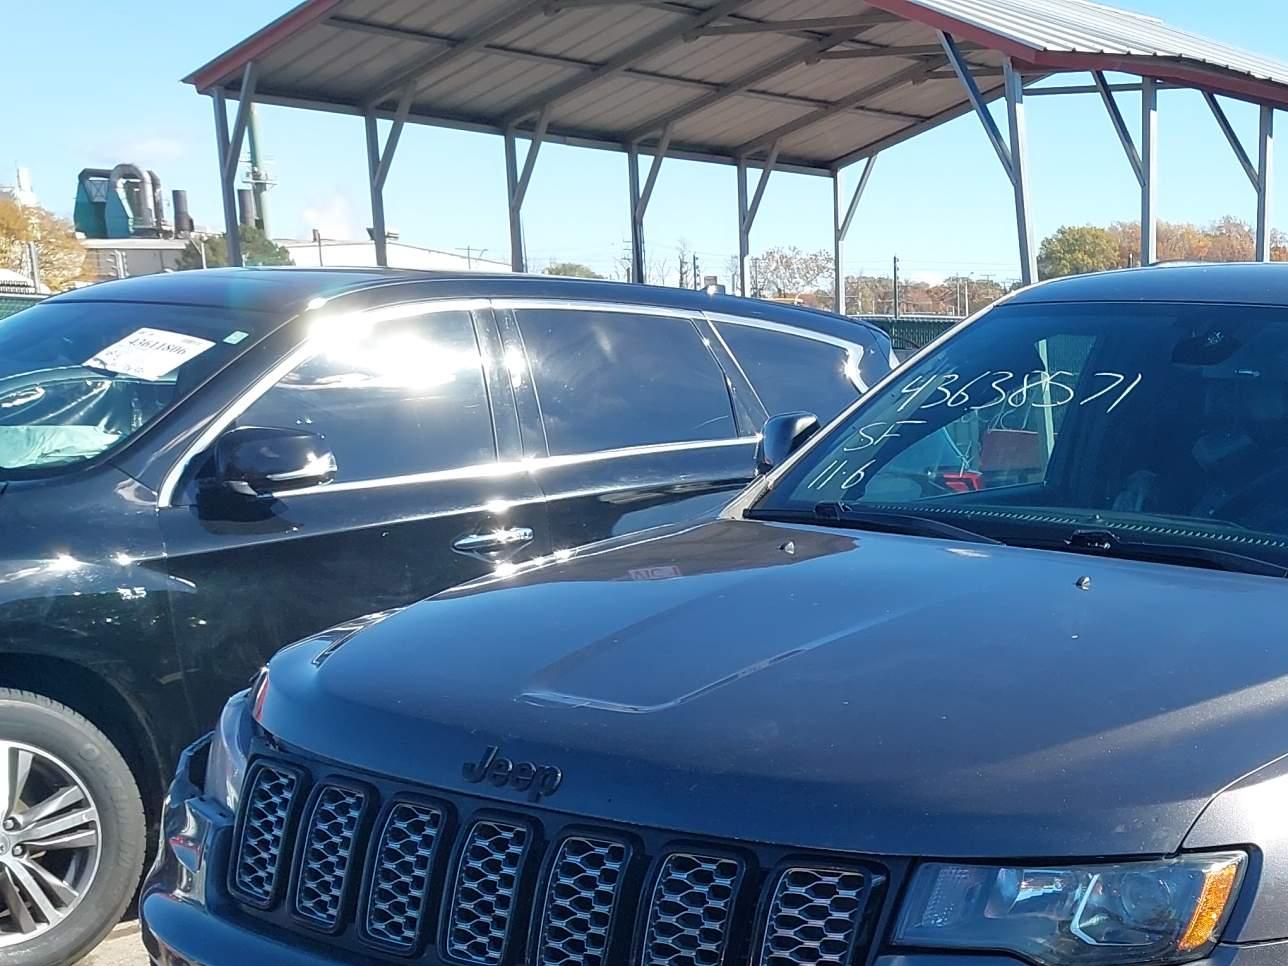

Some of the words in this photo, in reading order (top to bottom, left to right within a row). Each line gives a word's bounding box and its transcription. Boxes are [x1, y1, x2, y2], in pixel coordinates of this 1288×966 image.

[896, 370, 1143, 413] 43638571
[842, 420, 927, 452] SF
[463, 744, 562, 803] Jeep
